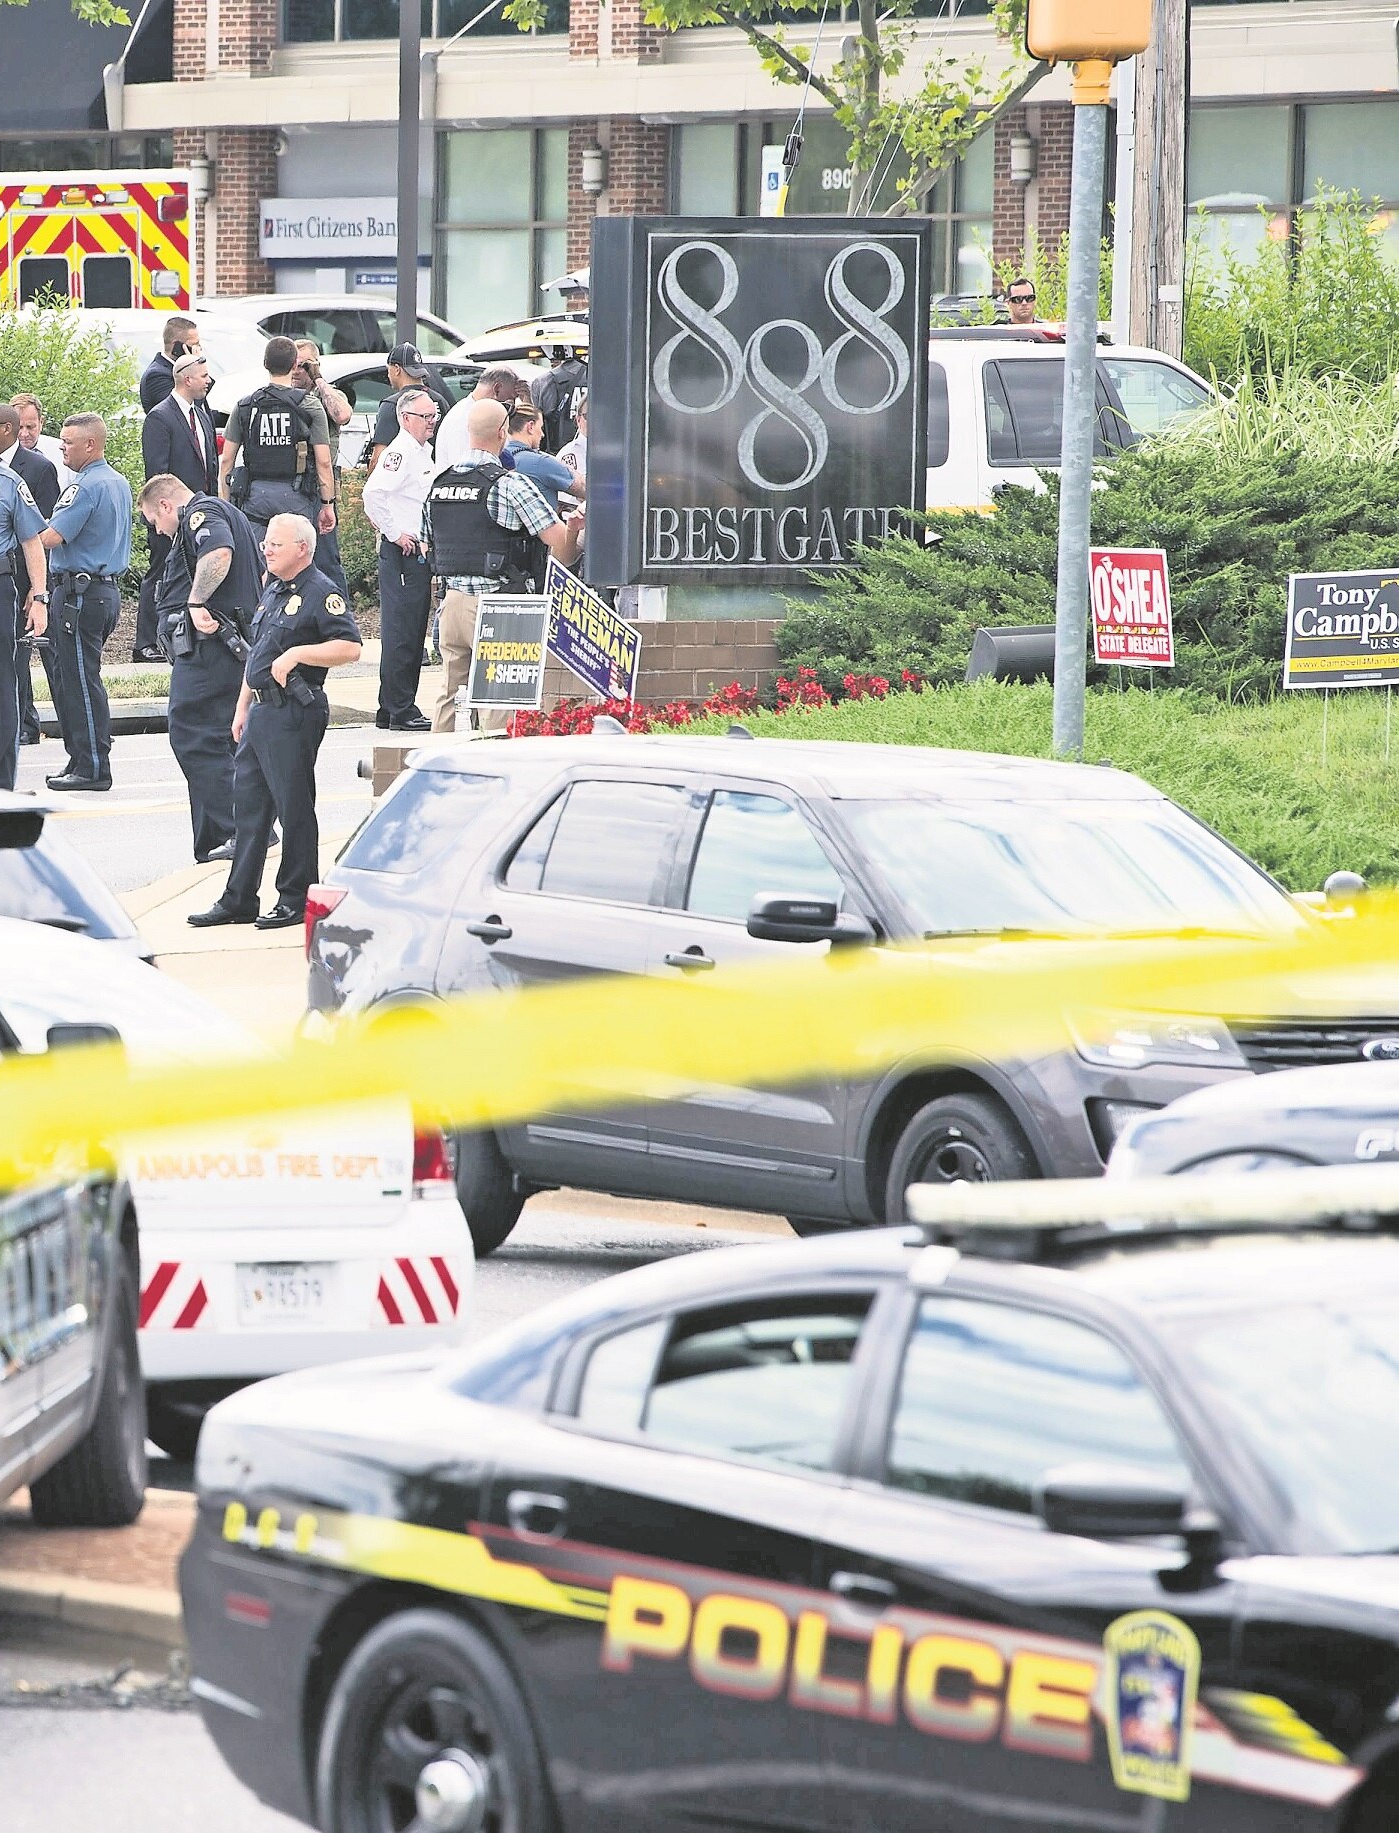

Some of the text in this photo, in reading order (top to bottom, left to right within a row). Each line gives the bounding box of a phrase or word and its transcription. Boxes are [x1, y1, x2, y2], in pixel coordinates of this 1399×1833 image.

[275, 216, 398, 238] First Citizens Ban
[653, 240, 911, 492] 888
[260, 413, 291, 436] ATF
[260, 436, 291, 446] POLICE
[430, 486, 481, 500] POLICE
[1094, 556, 1168, 625] O'SHEA
[1316, 583, 1380, 611] Tony
[564, 578, 635, 645] SHERIFF
[1294, 603, 1399, 645] Campb
[561, 591, 634, 674] BATEMAN
[1099, 634, 1169, 655] STATE DELEGATE
[1370, 637, 1391, 650] U.S.
[477, 642, 542, 662] FREDERICKS
[495, 664, 540, 684] SHERIFF
[136, 1153, 265, 1181] ANNAPOLIS
[276, 1154, 322, 1177] FIRE
[602, 1574, 1097, 1762] POLICE
